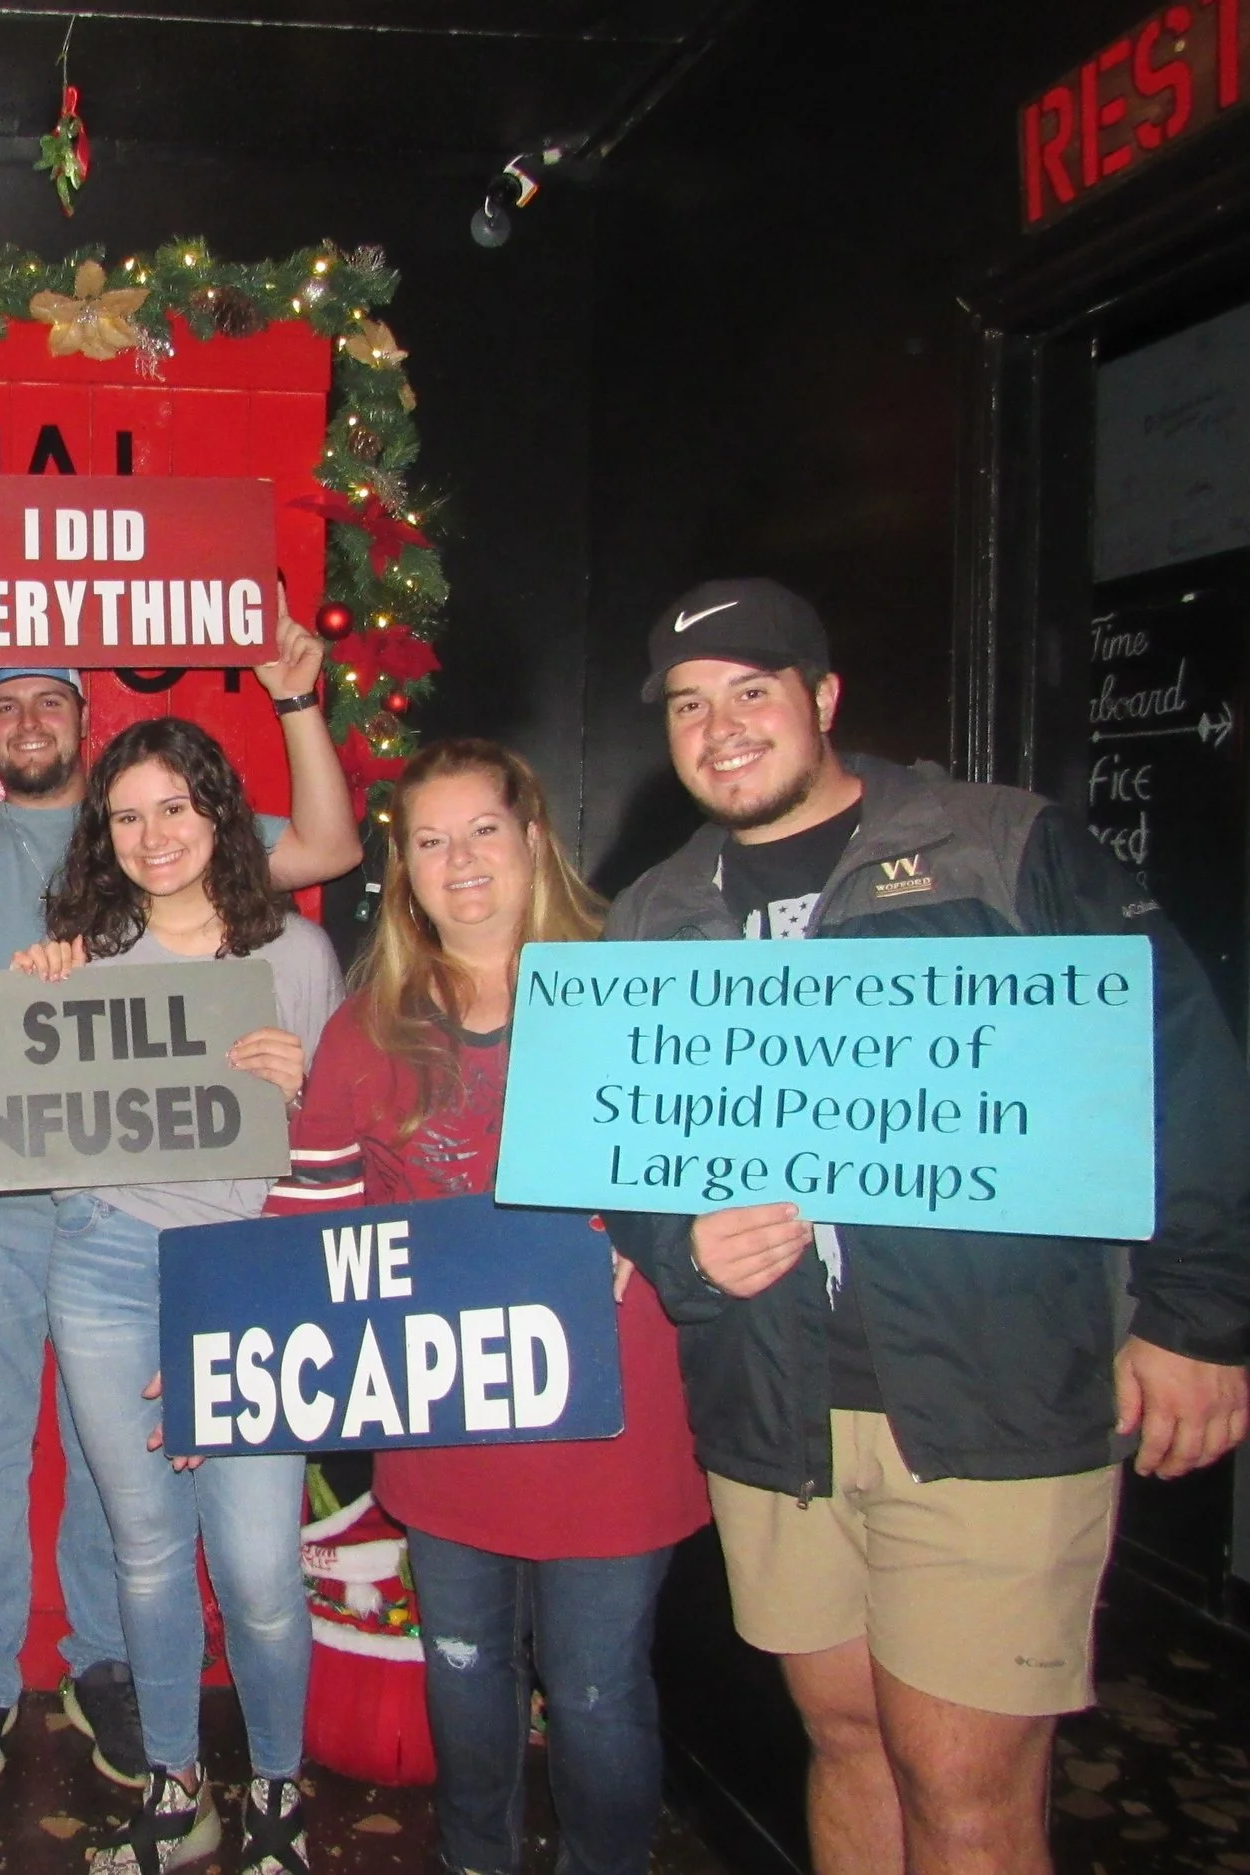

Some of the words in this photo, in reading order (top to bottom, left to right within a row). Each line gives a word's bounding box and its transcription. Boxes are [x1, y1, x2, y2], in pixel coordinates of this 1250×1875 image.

[24, 508, 39, 560] I
[56, 508, 145, 562] DID
[875, 877, 931, 891] WOFFORD
[528, 969, 676, 1007] Never
[689, 964, 1129, 1007] Underestimate
[22, 995, 207, 1065] STILL
[626, 1024, 711, 1066] the
[725, 1027, 912, 1068] Power
[928, 1024, 996, 1068] of
[592, 1084, 762, 1138] Stupid
[775, 1087, 961, 1144] People
[978, 1091, 1028, 1135] in
[610, 1144, 768, 1201] Large
[784, 1151, 997, 1212] Groups
[322, 1220, 412, 1303] WE
[192, 1303, 570, 1446] ESCAPED
